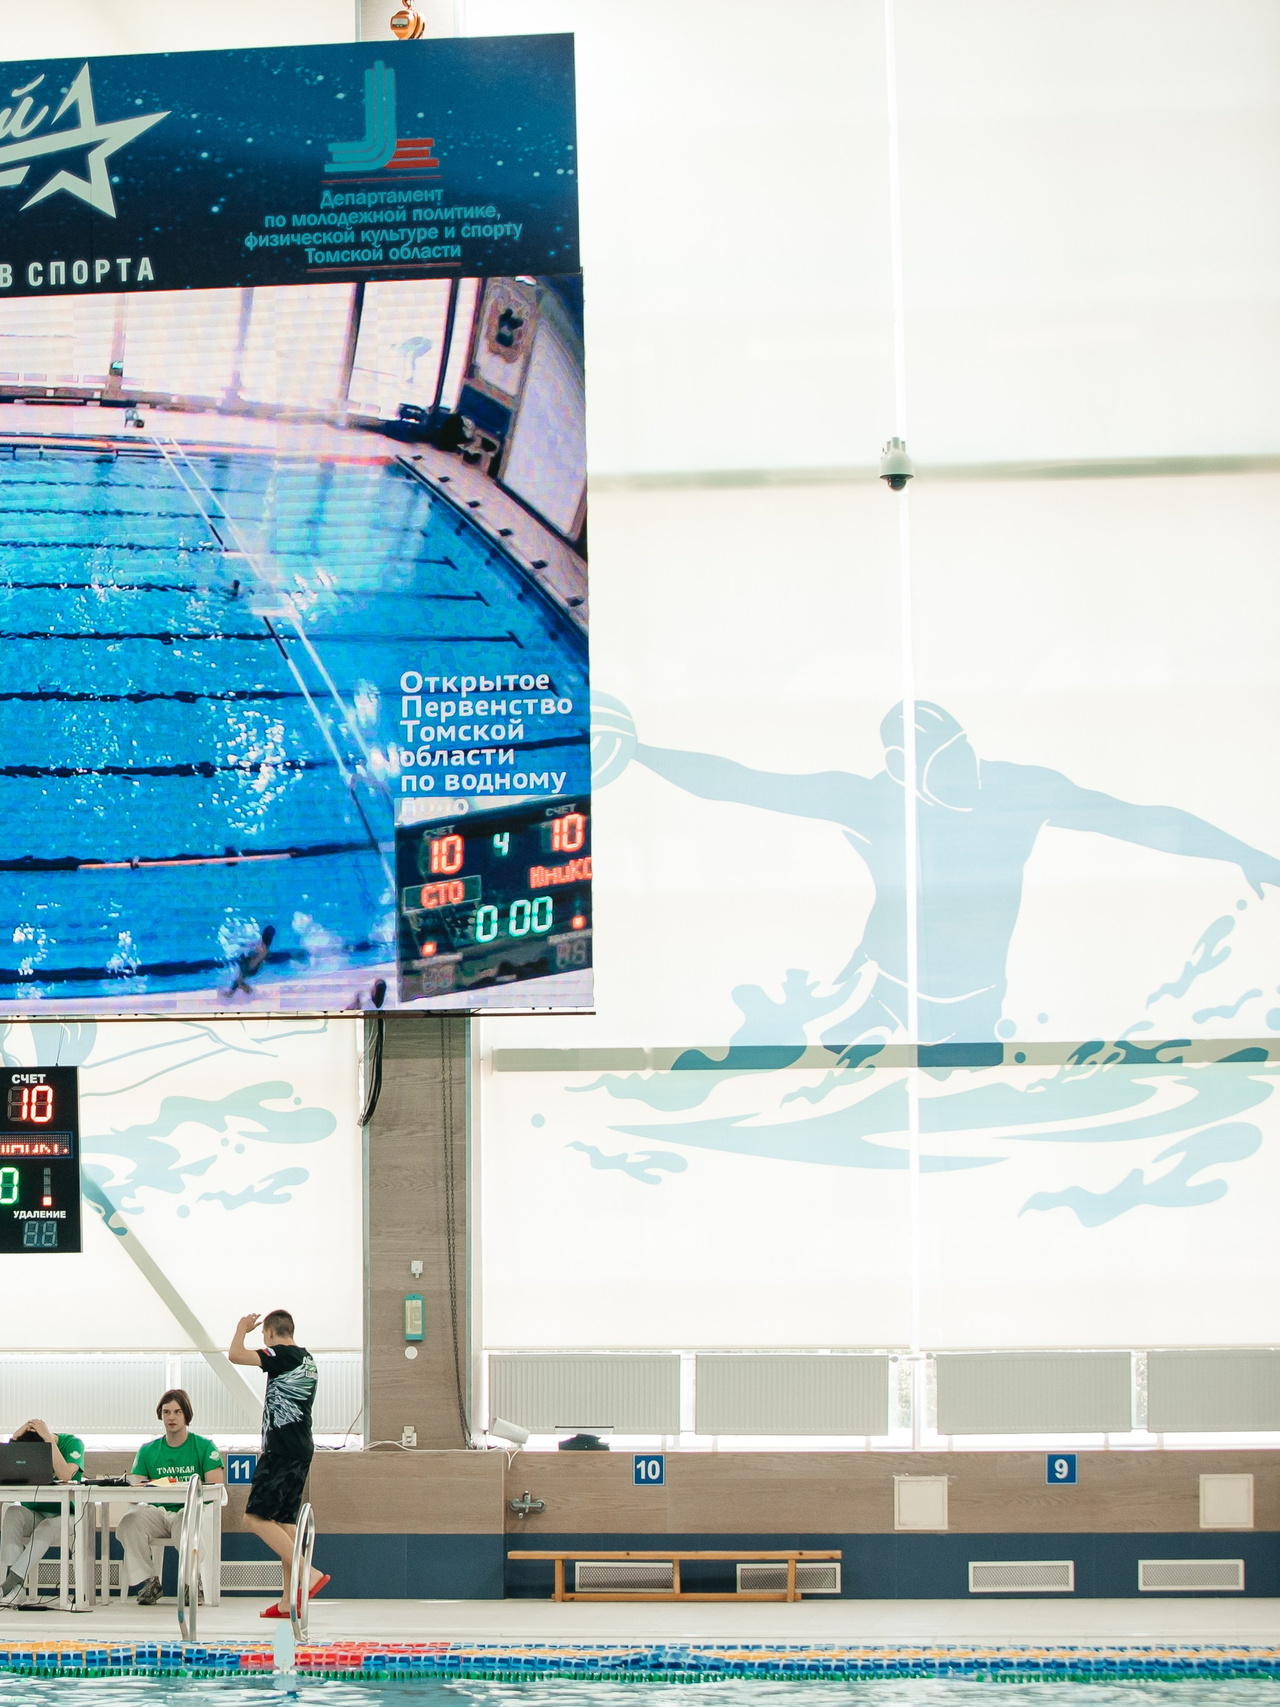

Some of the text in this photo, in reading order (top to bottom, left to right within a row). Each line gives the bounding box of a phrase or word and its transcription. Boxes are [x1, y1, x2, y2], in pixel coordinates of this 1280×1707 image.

[320, 188, 444, 209] Департамент
[264, 204, 501, 228] по молодежной политике,
[244, 222, 523, 250] физической культуре и спорту
[304, 243, 462, 264] Томской области
[28, 257, 155, 286] СПОРТА
[400, 670, 550, 698] Открытое
[401, 695, 573, 723] Первенство
[400, 718, 524, 743] Томской
[400, 745, 515, 767] области
[401, 771, 567, 793] по водному
[430, 812, 586, 875] 10 4 10
[421, 880, 465, 909] СТО
[11, 1073, 47, 1084] СЧЕТ
[21, 1085, 53, 1123] 10
[13, 1210, 67, 1219] УДАЛЕНИЕ
[230, 1460, 250, 1480] 11
[636, 1460, 661, 1480] 10
[1054, 1458, 1069, 1479] 9
